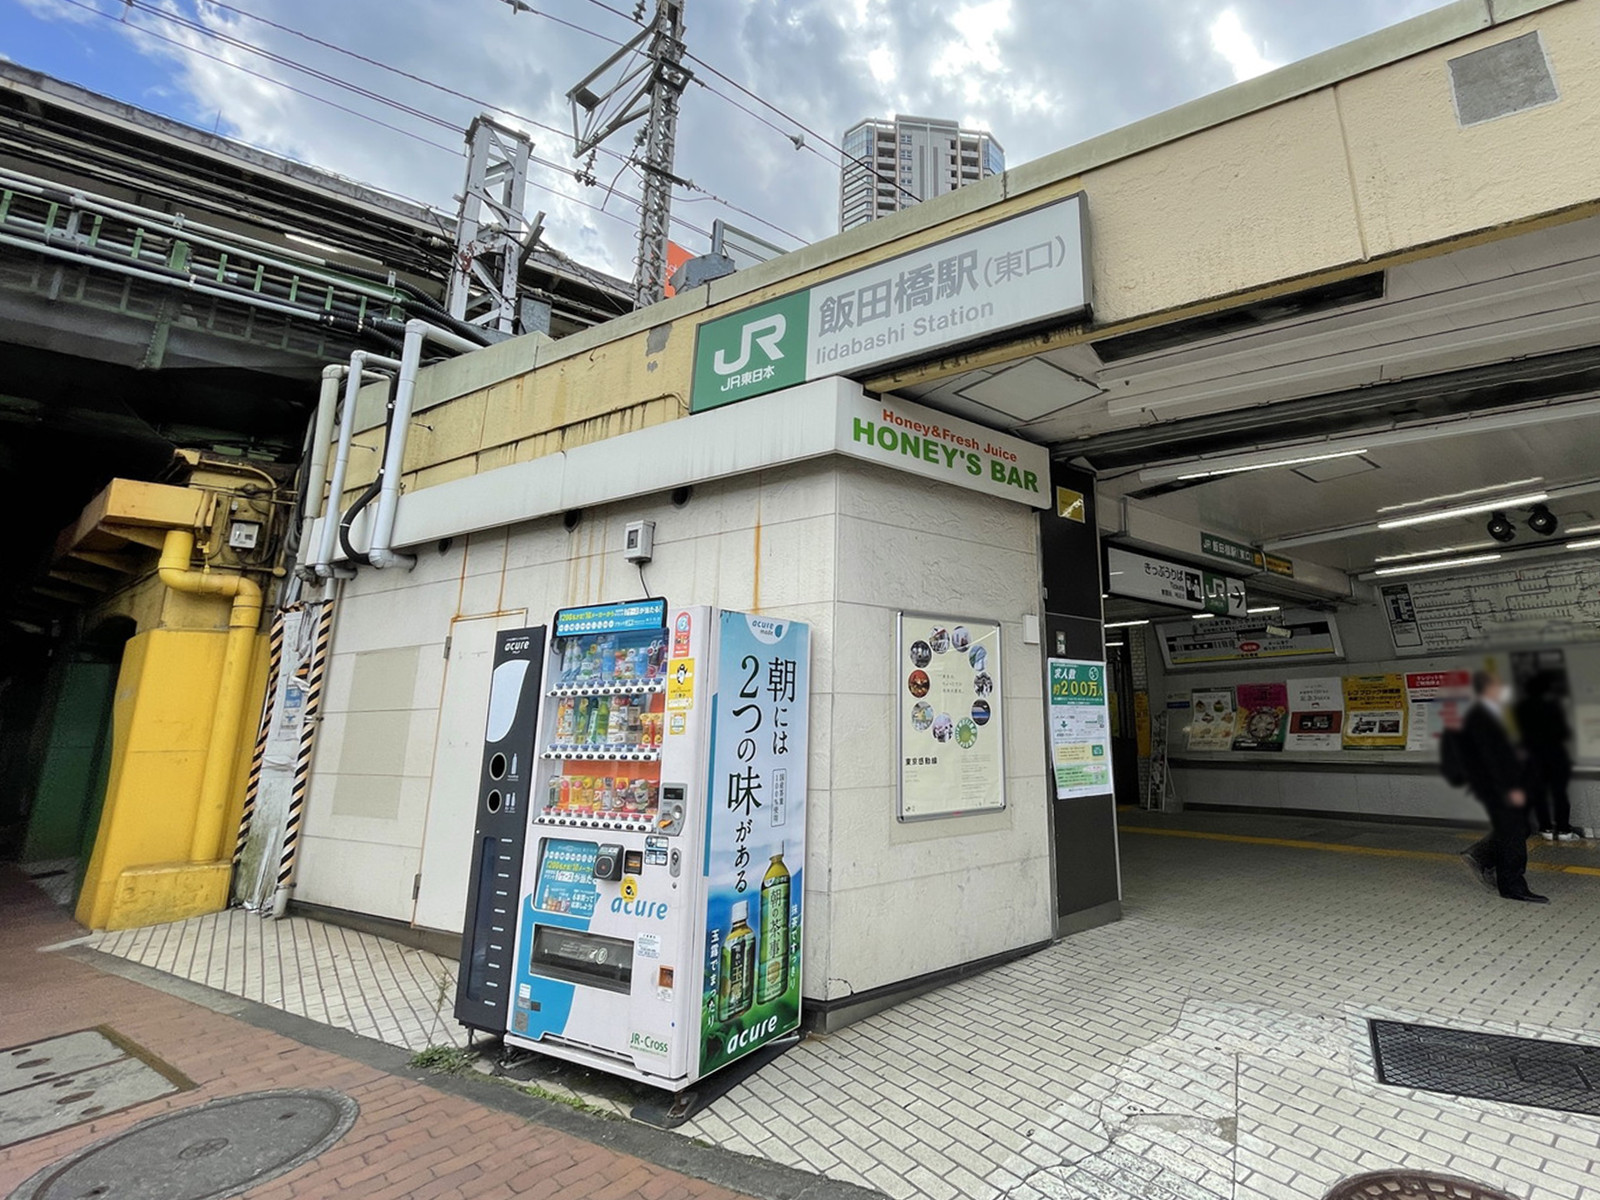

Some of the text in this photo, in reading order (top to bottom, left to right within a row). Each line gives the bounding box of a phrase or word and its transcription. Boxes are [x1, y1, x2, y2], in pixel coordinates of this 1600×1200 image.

[818, 235, 1066, 338] 飯田橋駅(東口)
[713, 313, 786, 376] JR
[816, 301, 994, 365] Iidabashi Station
[720, 365, 775, 392] JR東日本
[882, 408, 1017, 463] Honey&Fresh Juice
[853, 416, 1039, 493] HONEY'S BAR
[1144, 562, 1184, 581] きっぷうりば
[1206, 578, 1226, 600] JR
[752, 620, 775, 630] acure
[504, 641, 530, 651] acure
[1053, 667, 1077, 680] 求人数
[1053, 680, 1104, 697] 約200万人
[766, 656, 797, 756] 朝には
[727, 655, 763, 893] 2つの味がある
[611, 896, 668, 920] acure
[630, 1032, 669, 1053] JR-Cross
[727, 1014, 778, 1054] acure
